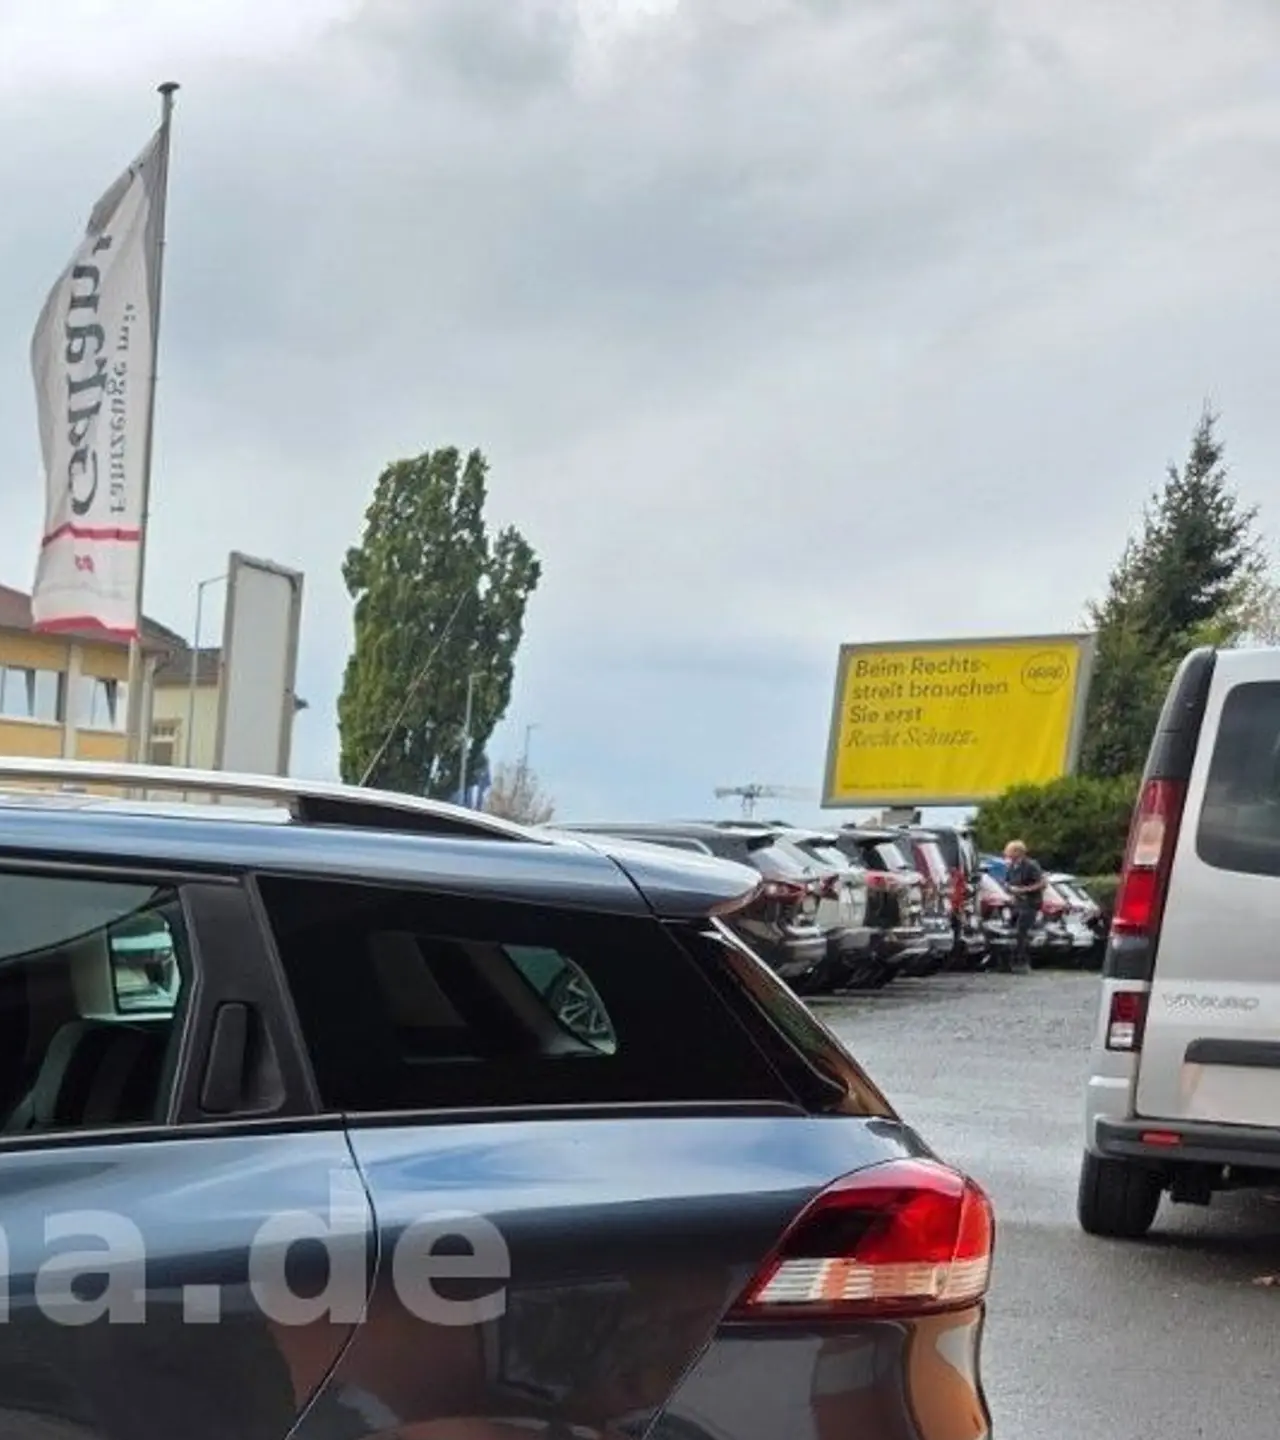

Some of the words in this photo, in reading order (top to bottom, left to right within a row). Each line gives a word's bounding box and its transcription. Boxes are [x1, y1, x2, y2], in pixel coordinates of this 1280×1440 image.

[856, 659, 904, 678] Beim
[909, 678, 1009, 698] brauchen
[850, 705, 879, 724] Sie
[884, 706, 922, 722] erst
